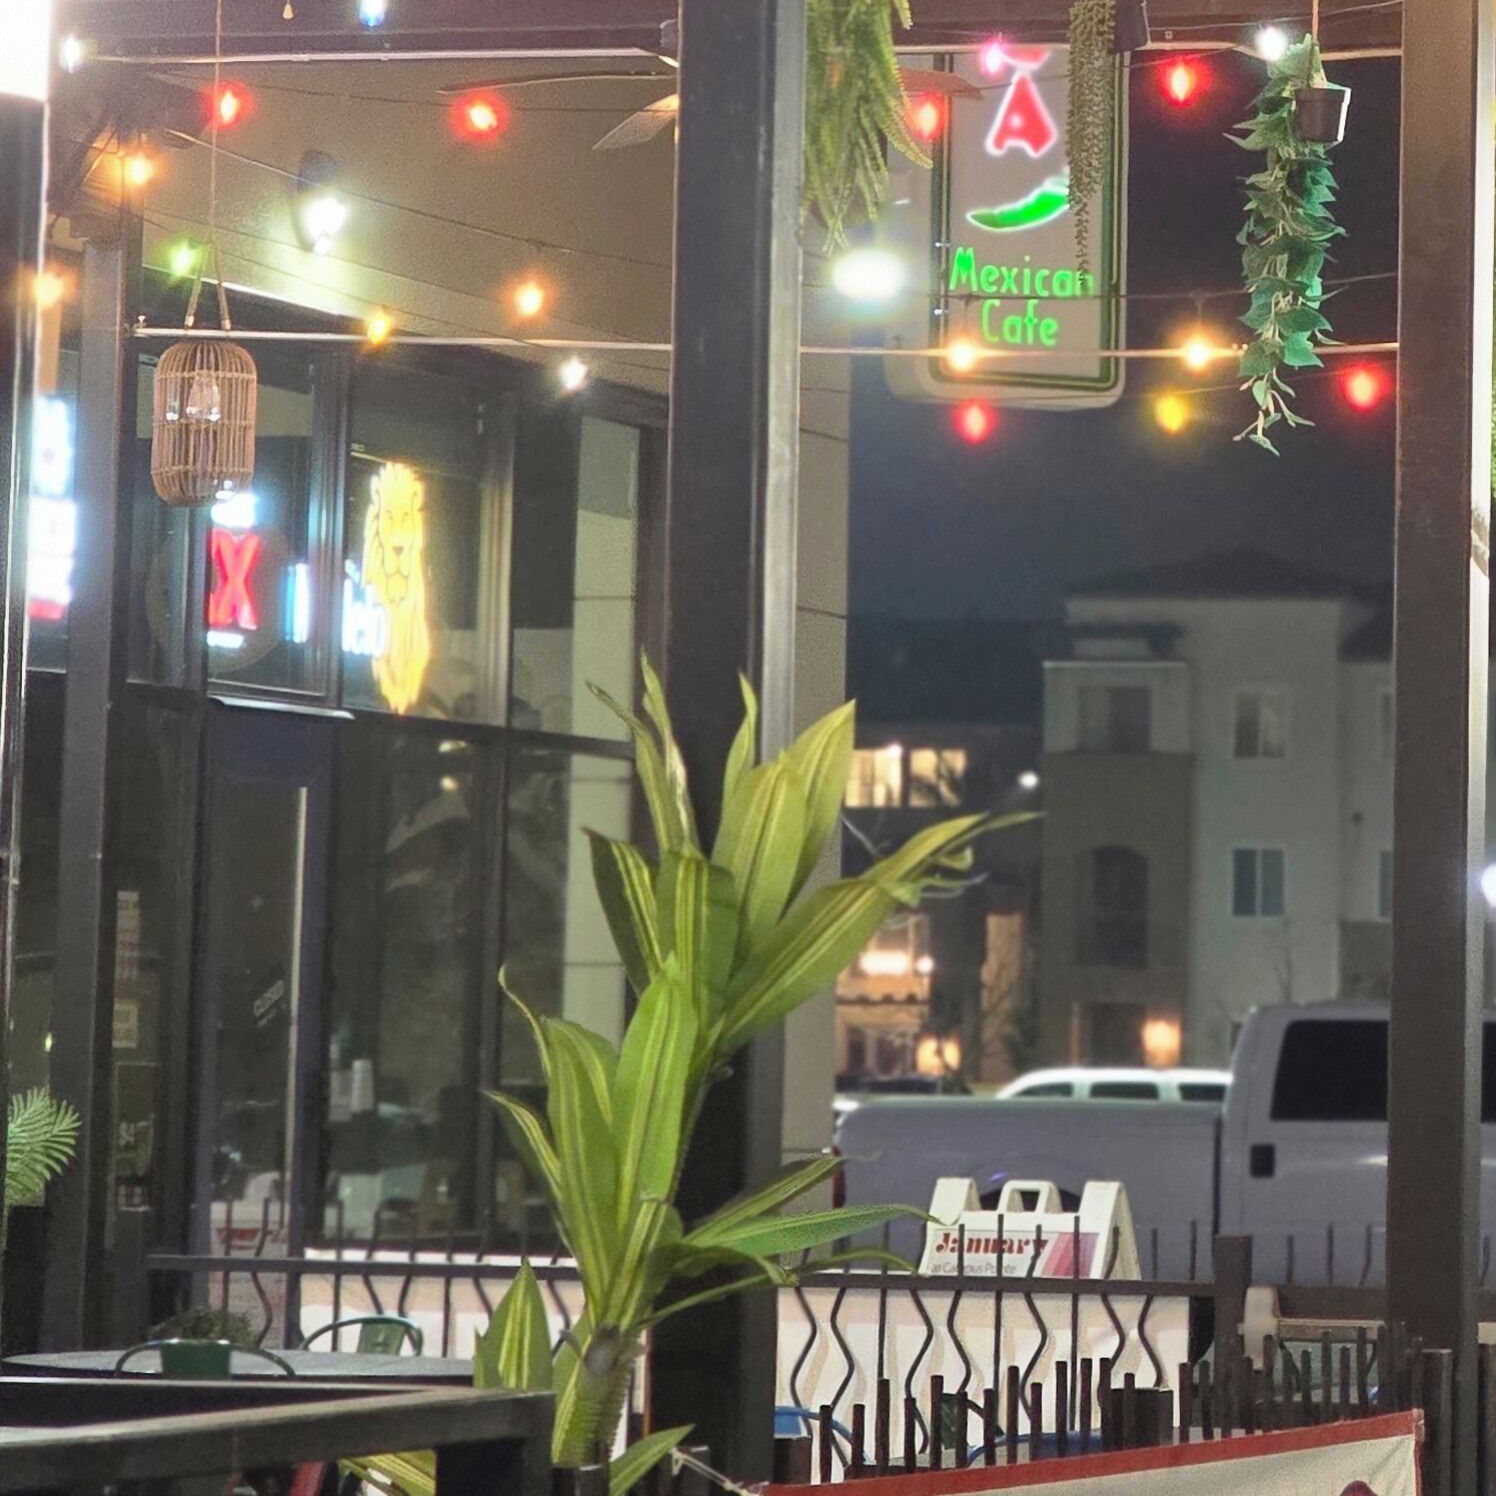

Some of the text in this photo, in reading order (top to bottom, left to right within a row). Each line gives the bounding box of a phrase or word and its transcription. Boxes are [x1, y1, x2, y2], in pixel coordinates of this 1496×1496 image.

[949, 246, 1095, 298] Mexican
[981, 298, 1059, 346] Cafe
[935, 1232, 1048, 1261] January
[985, 1261, 1016, 1275] Ponte
